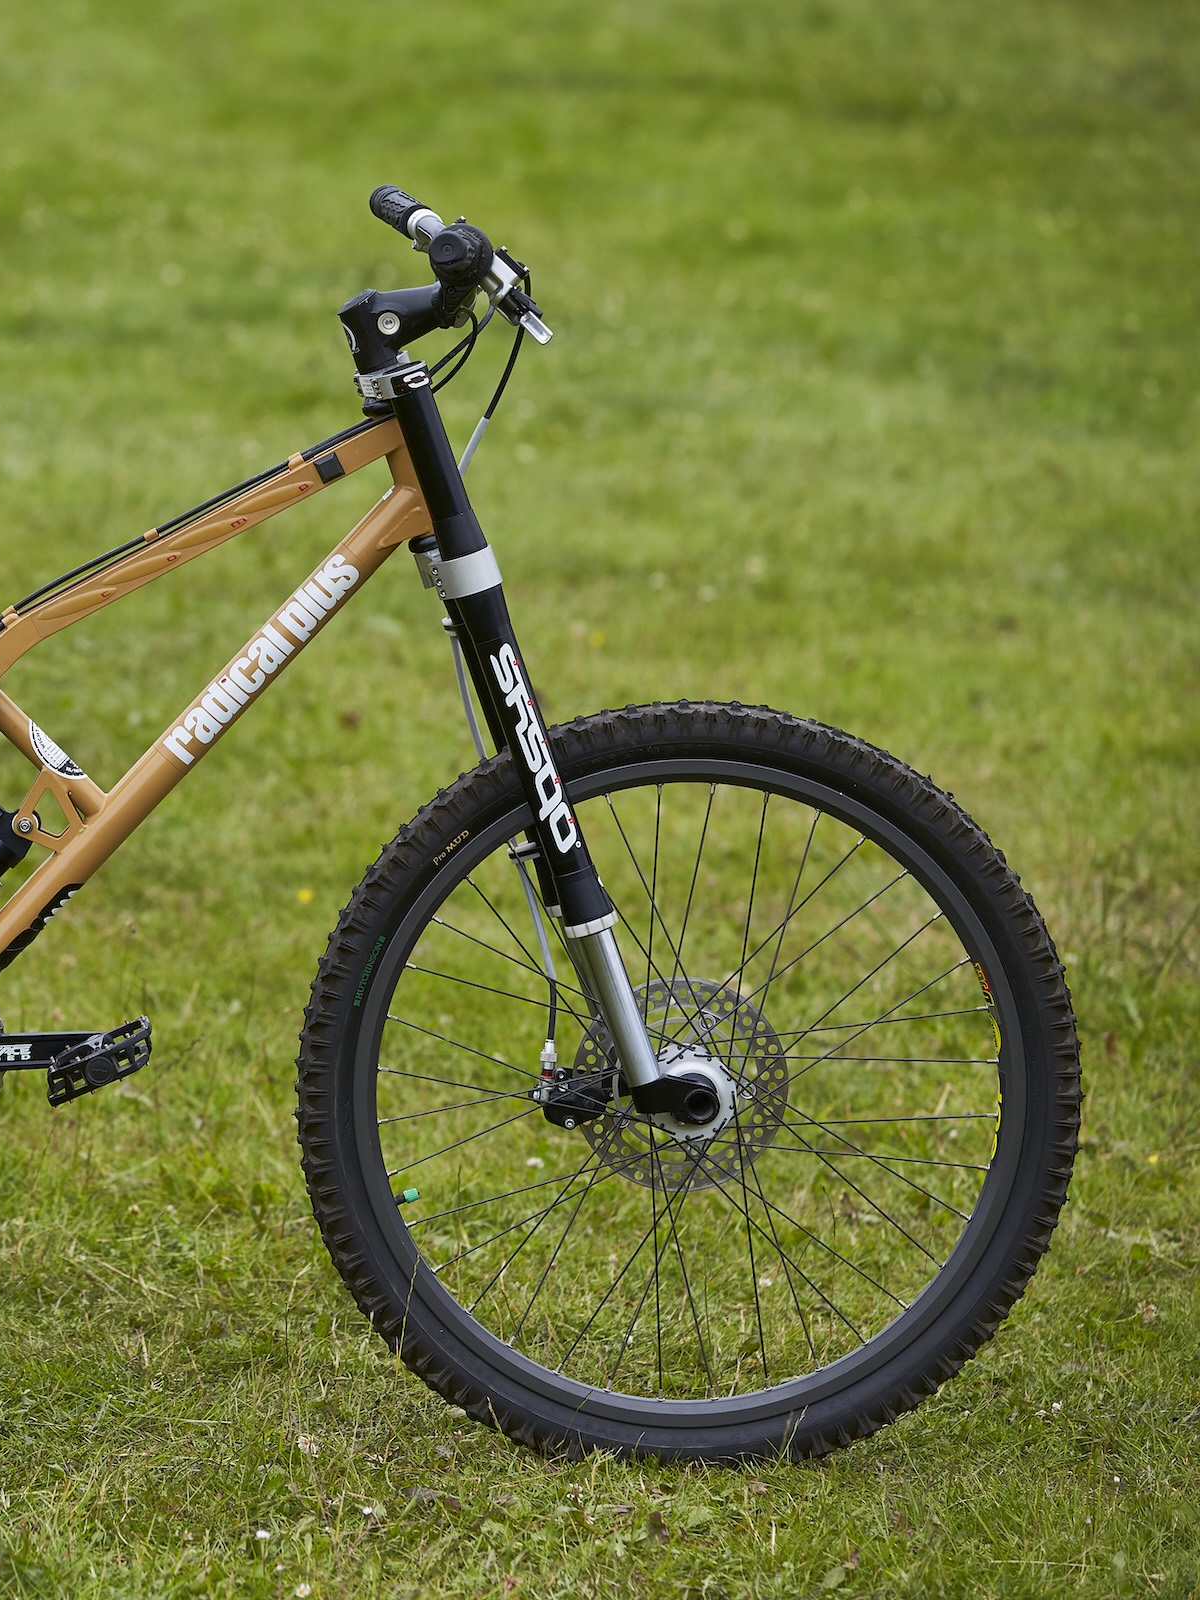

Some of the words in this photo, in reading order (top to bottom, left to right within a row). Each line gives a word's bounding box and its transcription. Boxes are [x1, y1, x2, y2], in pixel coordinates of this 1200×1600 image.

[163, 623, 295, 766] radical
[277, 553, 360, 643] plus
[432, 850, 447, 866] Pro
[445, 829, 471, 854] MUD
[355, 940, 382, 1000] HUTCHINSON
